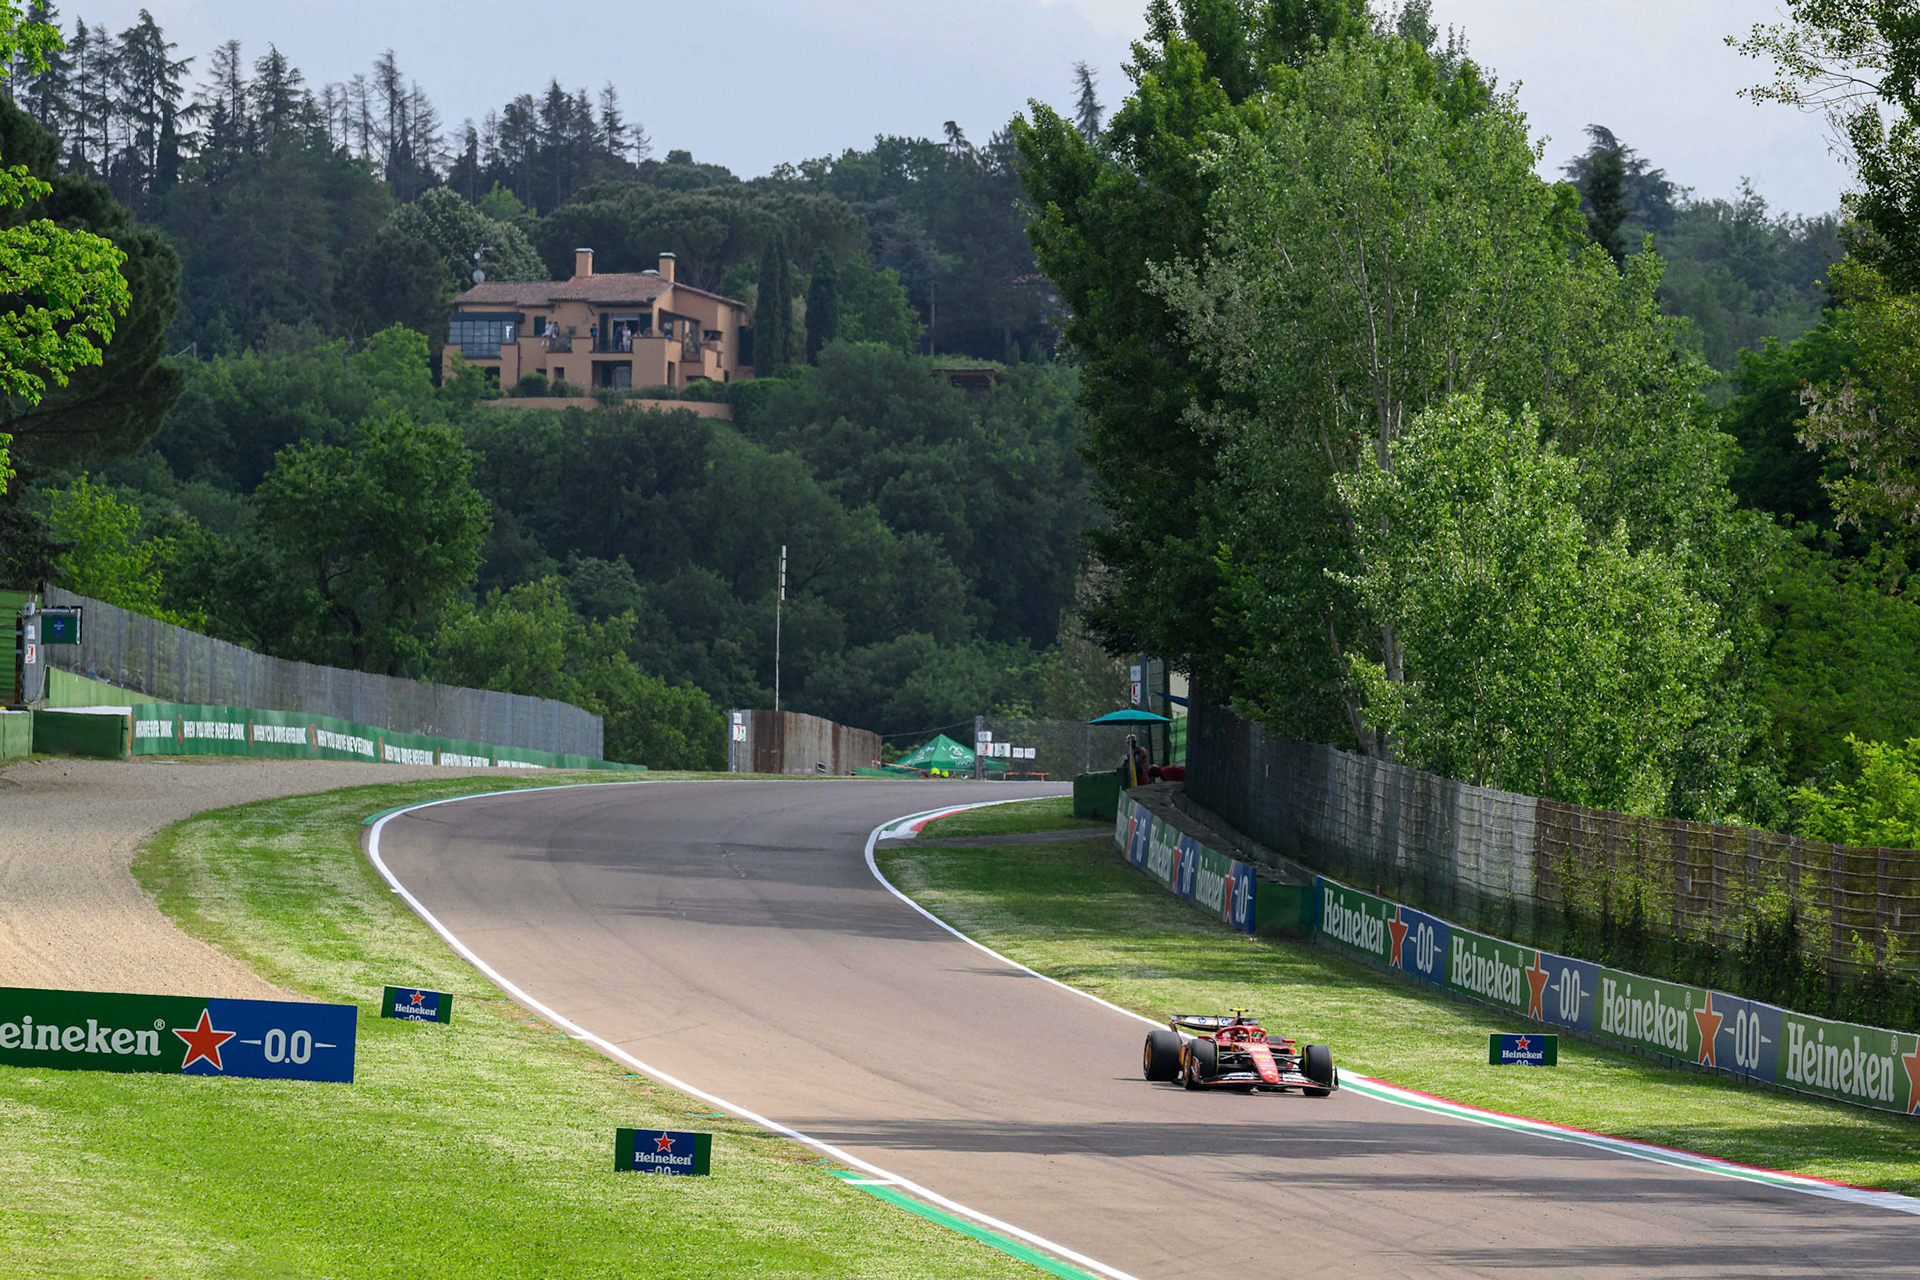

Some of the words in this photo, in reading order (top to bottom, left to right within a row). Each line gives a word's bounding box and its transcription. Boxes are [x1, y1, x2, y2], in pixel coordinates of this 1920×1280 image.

[1322, 887, 1384, 956] Heineken
[1416, 922, 1434, 974] 0.0
[1451, 935, 1521, 1006] Heineken
[1559, 967, 1581, 1022] 0.0
[395, 1003, 436, 1016] Heineken
[1601, 977, 1689, 1053] Heineken
[1735, 1009, 1760, 1070] 0.0
[264, 1028, 312, 1065] 0.0
[1502, 1050, 1543, 1060] Heineken
[1786, 1022, 1895, 1102] Heineken
[635, 1151, 691, 1166] Heineken
